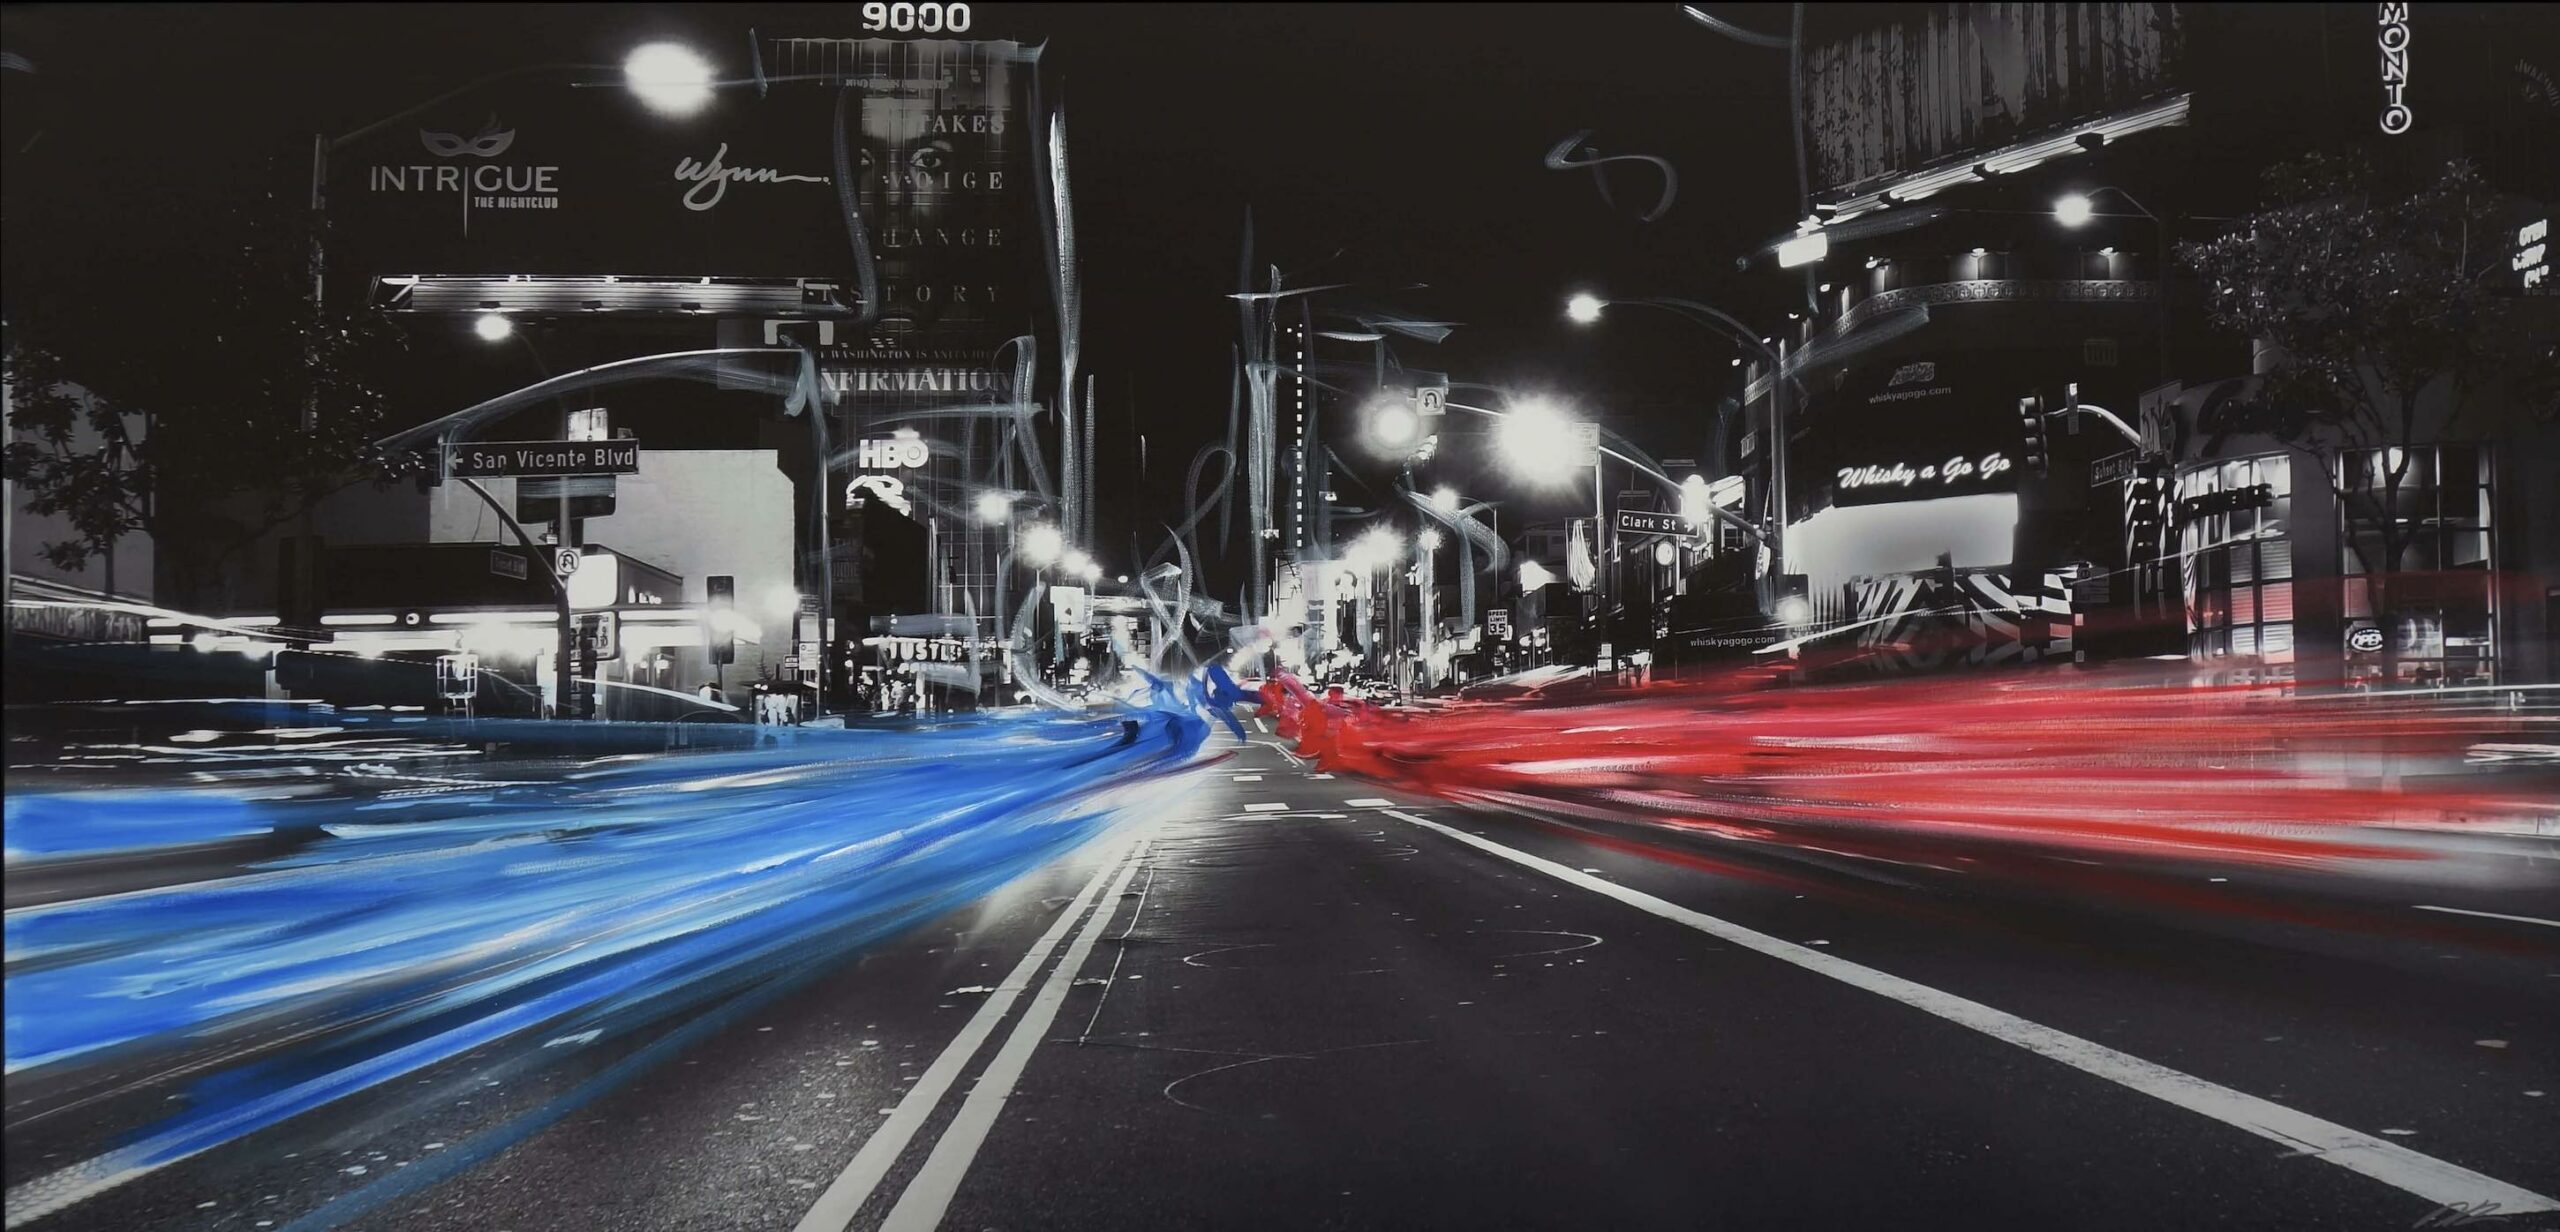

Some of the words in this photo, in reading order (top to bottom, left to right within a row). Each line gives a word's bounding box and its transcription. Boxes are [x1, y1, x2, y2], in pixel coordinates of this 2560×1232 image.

[862, 2, 971, 33] 9000
[474, 196, 494, 208] THE
[498, 196, 559, 209] NIGHTCLUB
[473, 451, 507, 469] San
[516, 450, 586, 468] Vicente
[594, 448, 634, 466] Blvd
[859, 439, 929, 468] HBO
[1837, 462, 1917, 489] Whisky
[1920, 465, 1936, 479] a
[1942, 455, 1974, 484] Go
[1979, 452, 2011, 480] Go
[1621, 515, 1655, 529] Clark
[1662, 518, 1676, 531] St
[1489, 623, 1506, 633] 35
